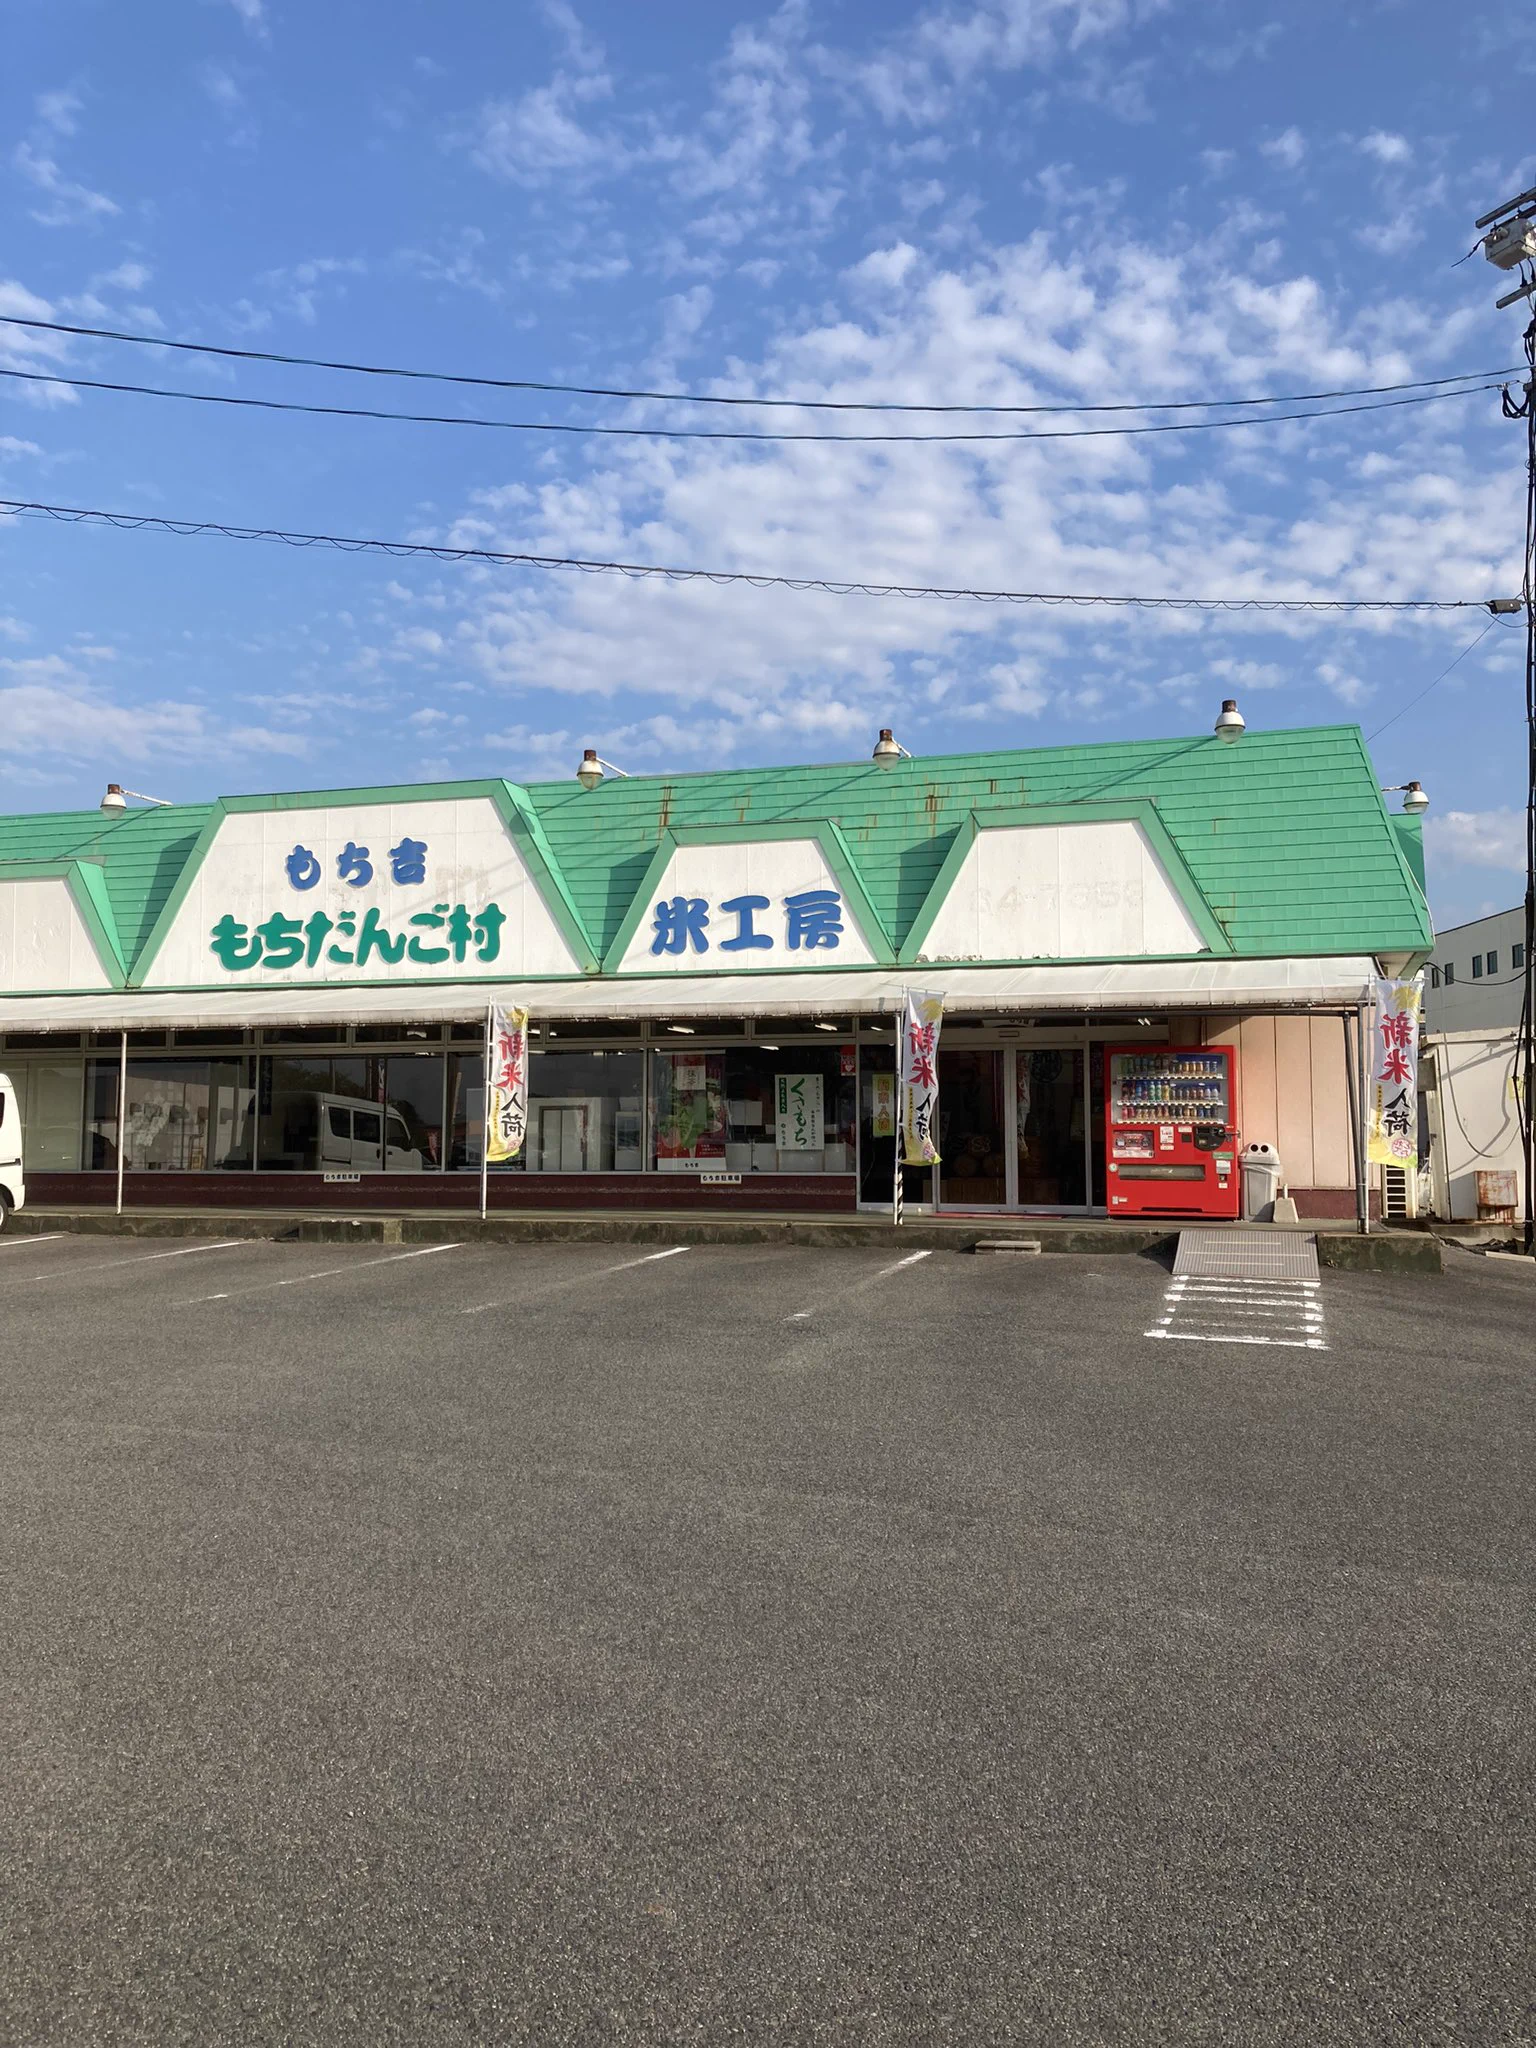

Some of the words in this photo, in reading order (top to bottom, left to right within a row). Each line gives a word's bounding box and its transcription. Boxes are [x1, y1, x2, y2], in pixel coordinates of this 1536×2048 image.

[286, 838, 428, 890] もち吉
[211, 903, 507, 970] もちだんご村
